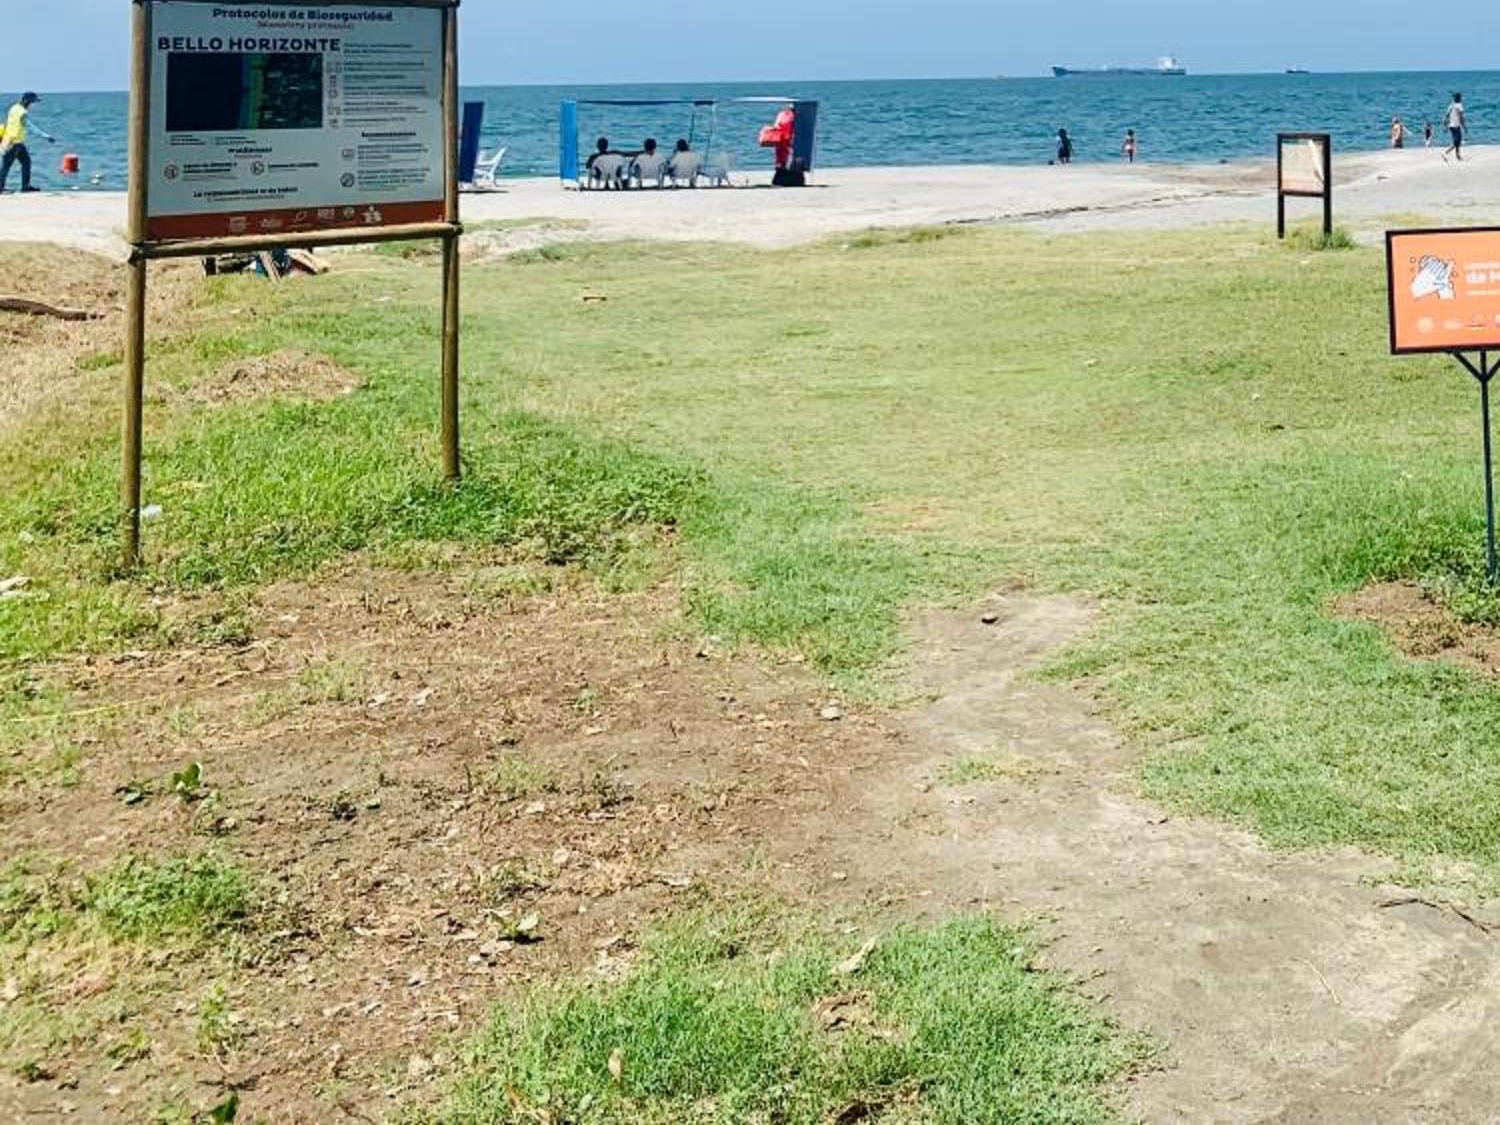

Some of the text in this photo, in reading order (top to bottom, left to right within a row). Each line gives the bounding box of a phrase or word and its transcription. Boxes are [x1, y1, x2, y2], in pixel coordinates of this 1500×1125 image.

[213, 8, 286, 19] Protocolos
[158, 36, 223, 51] BELLO
[229, 37, 341, 52] HORIZONTE
